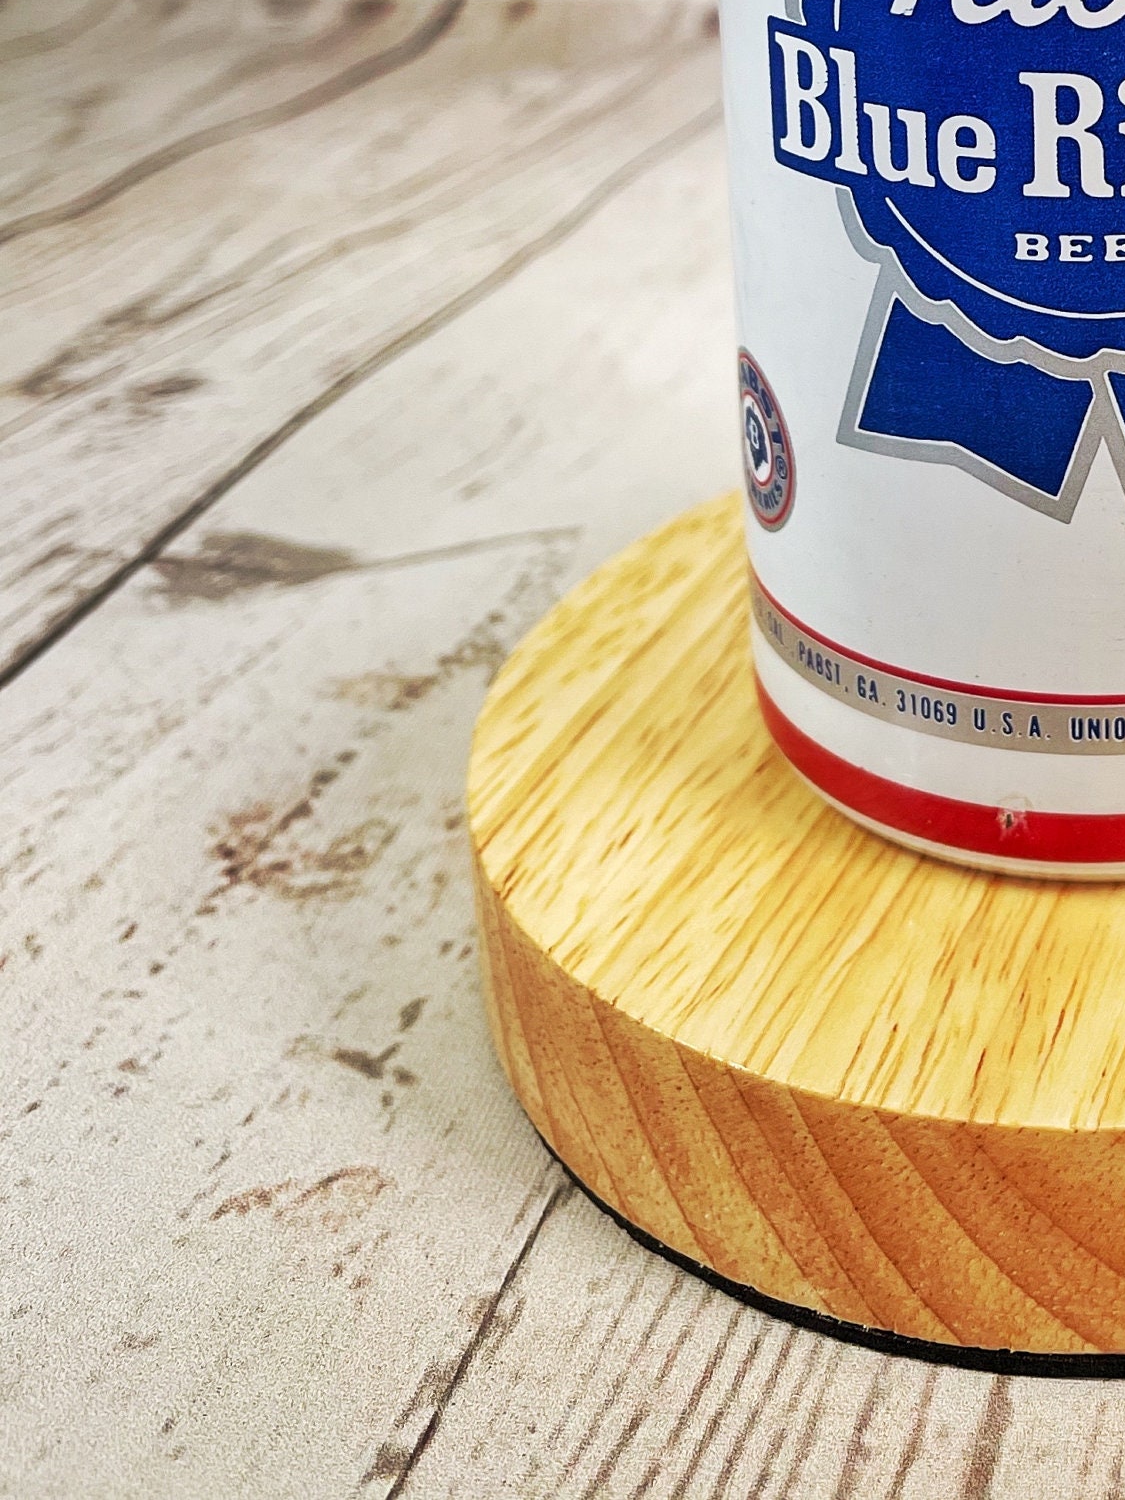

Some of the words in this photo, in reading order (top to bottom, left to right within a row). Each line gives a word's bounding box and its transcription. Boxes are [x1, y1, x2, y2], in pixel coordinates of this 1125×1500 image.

[774, 30, 997, 194] Blue
[856, 674, 886, 707] GA.
[896, 689, 958, 726] 31069
[973, 707, 1051, 740] U.S.A.
